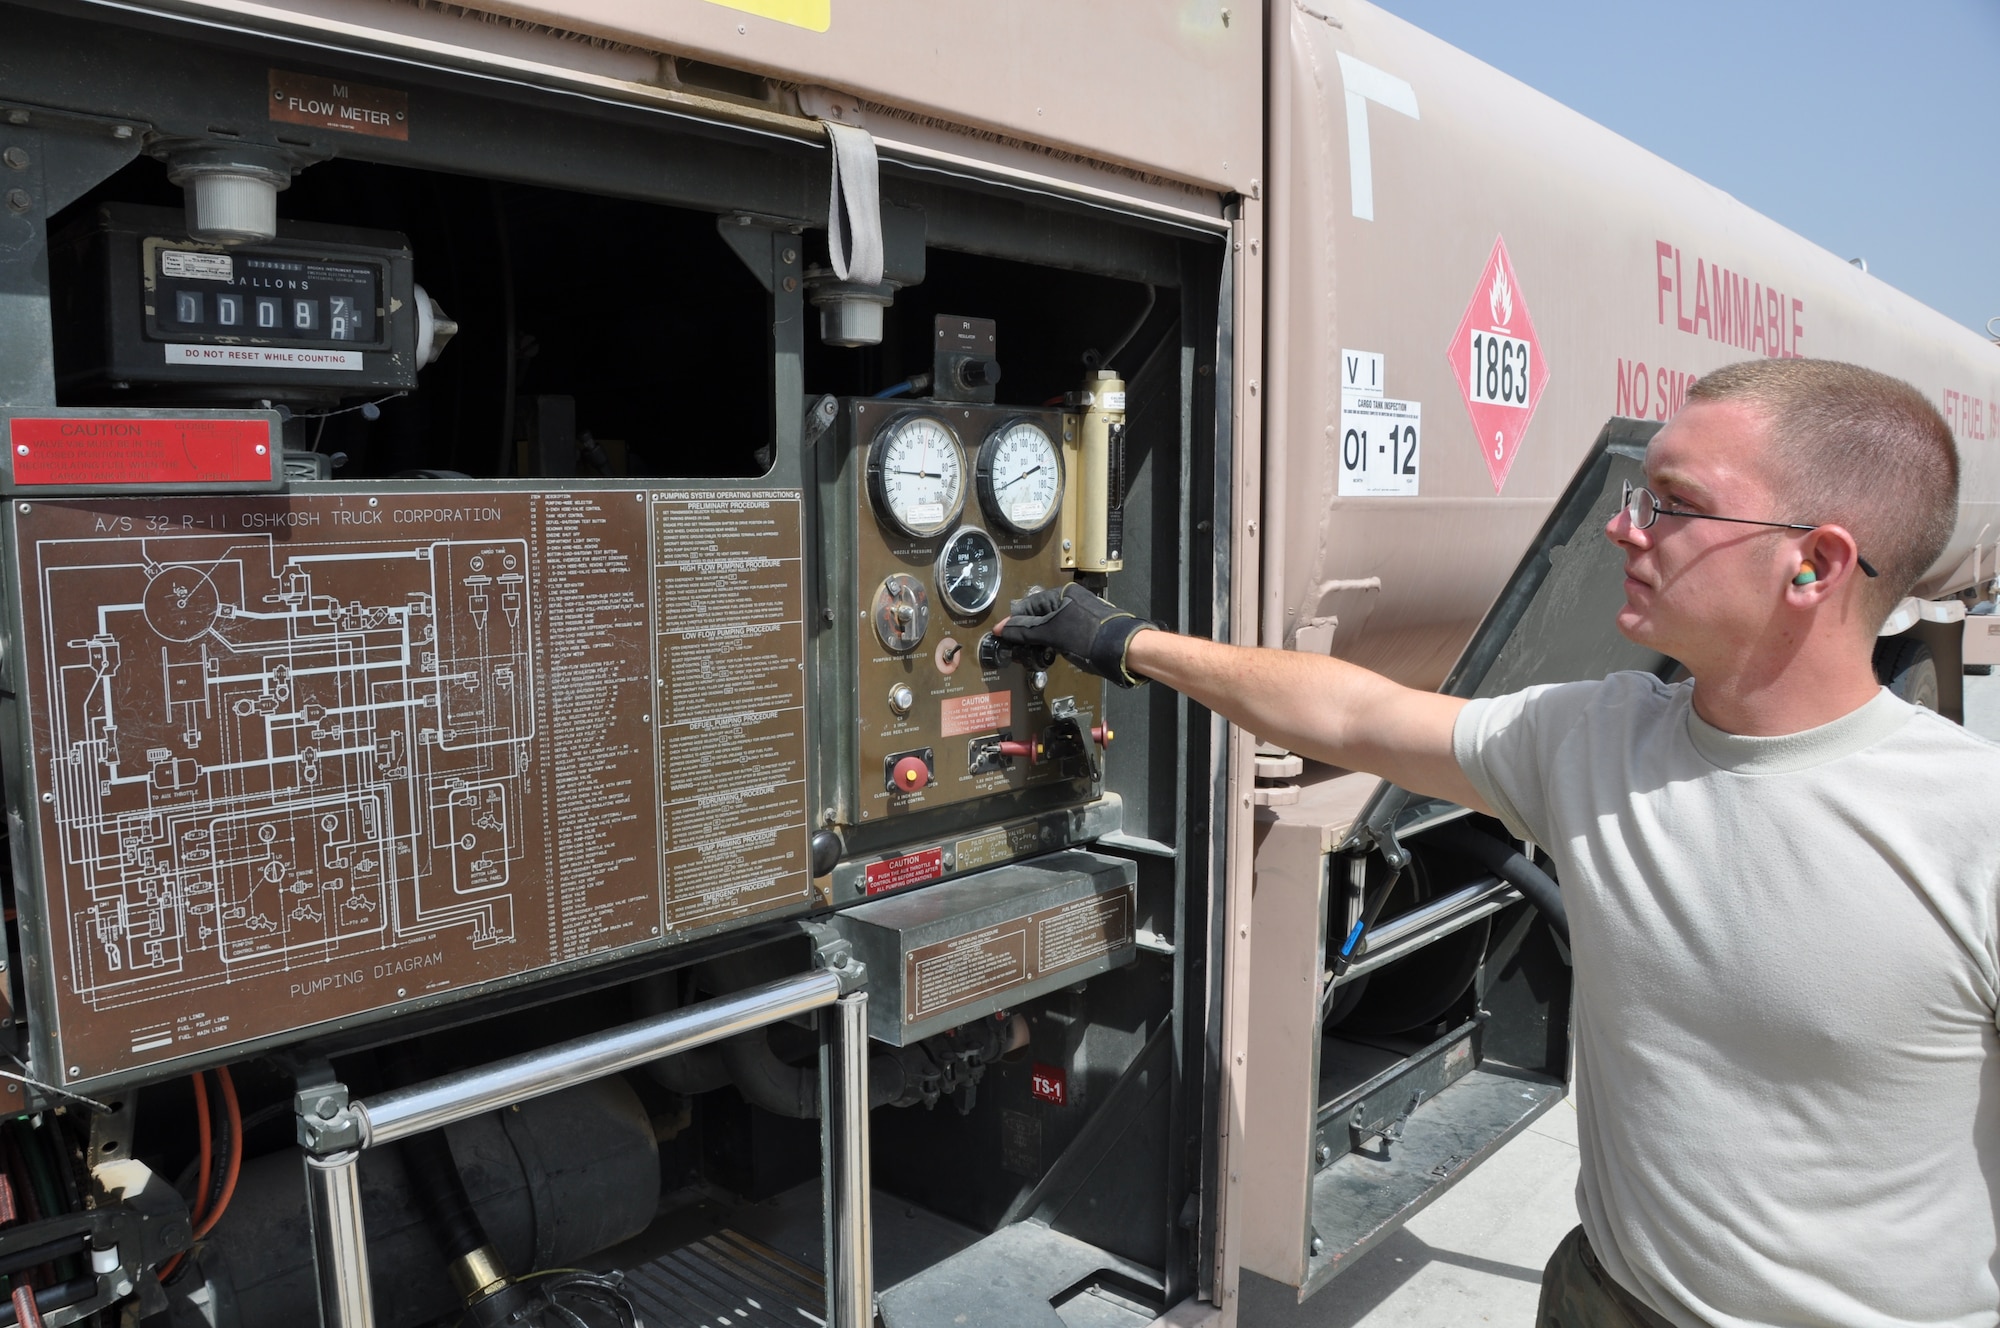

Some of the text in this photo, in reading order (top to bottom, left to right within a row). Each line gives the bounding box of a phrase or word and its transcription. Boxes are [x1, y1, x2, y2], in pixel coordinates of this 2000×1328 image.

[289, 98, 390, 126] FLOW METER
[227, 277, 309, 290] GALLONS
[1656, 240, 1804, 359] FLAMMABLE
[186, 349, 346, 363] DO NOT RESET WHILE COUNTING
[1347, 356, 1358, 384] V
[1474, 334, 1527, 404] 1863
[1616, 358, 1649, 418] NO
[1358, 399, 1407, 411] CARGO TANK INSPECTION
[1962, 394, 1985, 440] FUEL
[60, 422, 214, 437] CAUTION CLOSED
[33, 440, 65, 448] VALVE
[88, 440, 115, 448] MUST
[118, 440, 130, 448] BE
[133, 440, 142, 448] IN
[145, 440, 164, 448] THE
[898, 435, 943, 460] 50 40 60 30 70
[1011, 439, 1038, 452] 100 80 120
[1344, 429, 1366, 471] 01
[1495, 431, 1503, 460] 3
[33, 451, 75, 459] CLOSED
[77, 451, 124, 459] POSITION
[1004, 453, 1044, 462] 60 140
[19, 461, 180, 470] RECIRCULATING FUEL WHEN THE
[894, 463, 948, 474] 20 80
[1000, 467, 1006, 475] 40
[50, 472, 152, 480] CARGO TANK IS FULL
[896, 479, 948, 491] 10 90
[1001, 480, 1046, 490] 20 180
[1034, 492, 1042, 500] 200
[688, 502, 728, 510] PRELIMINARY
[95, 508, 501, 532] A/S 32 R-11 OSHKOSH TRUCK CORPORATION
[717, 562, 744, 570] PUMPING
[746, 560, 780, 568] PROCEDURE
[682, 625, 780, 640] LOW FLOW PUMPING PROCEDURE
[962, 696, 990, 706] CAUTION
[690, 712, 778, 730] DEFUEL PUMPING PROCEDURE
[174, 789, 199, 798] THROTTLE
[698, 788, 775, 807] DEDRUMMING PROCEDURE
[698, 832, 777, 853] PUMP PRIMING PROCEDURE
[986, 834, 1007, 843] CONTROL
[1008, 828, 1025, 838] VALVES
[889, 856, 920, 869] CAUTION
[870, 878, 891, 888] CONTROL
[898, 872, 915, 882] BEFORE
[925, 866, 938, 875] AFTER
[878, 872, 890, 880] PUSH
[910, 862, 931, 873] THROTTLE
[886, 881, 905, 890] PUMPING
[906, 873, 932, 886] OPERATIONS
[703, 880, 776, 902] EMERGENCY PROCEDURE
[1071, 902, 1085, 910] SAMPLING
[959, 936, 977, 945] DEFUELING
[978, 929, 998, 939] PROCEDURE
[290, 952, 442, 998] PUMPING DIAGRAM
[176, 1012, 205, 1023] AIR LINES
[194, 1020, 209, 1029] PILOT
[212, 1016, 229, 1025] LINES
[212, 1025, 227, 1034] LINES
[1033, 1077, 1060, 1097] TS-1
